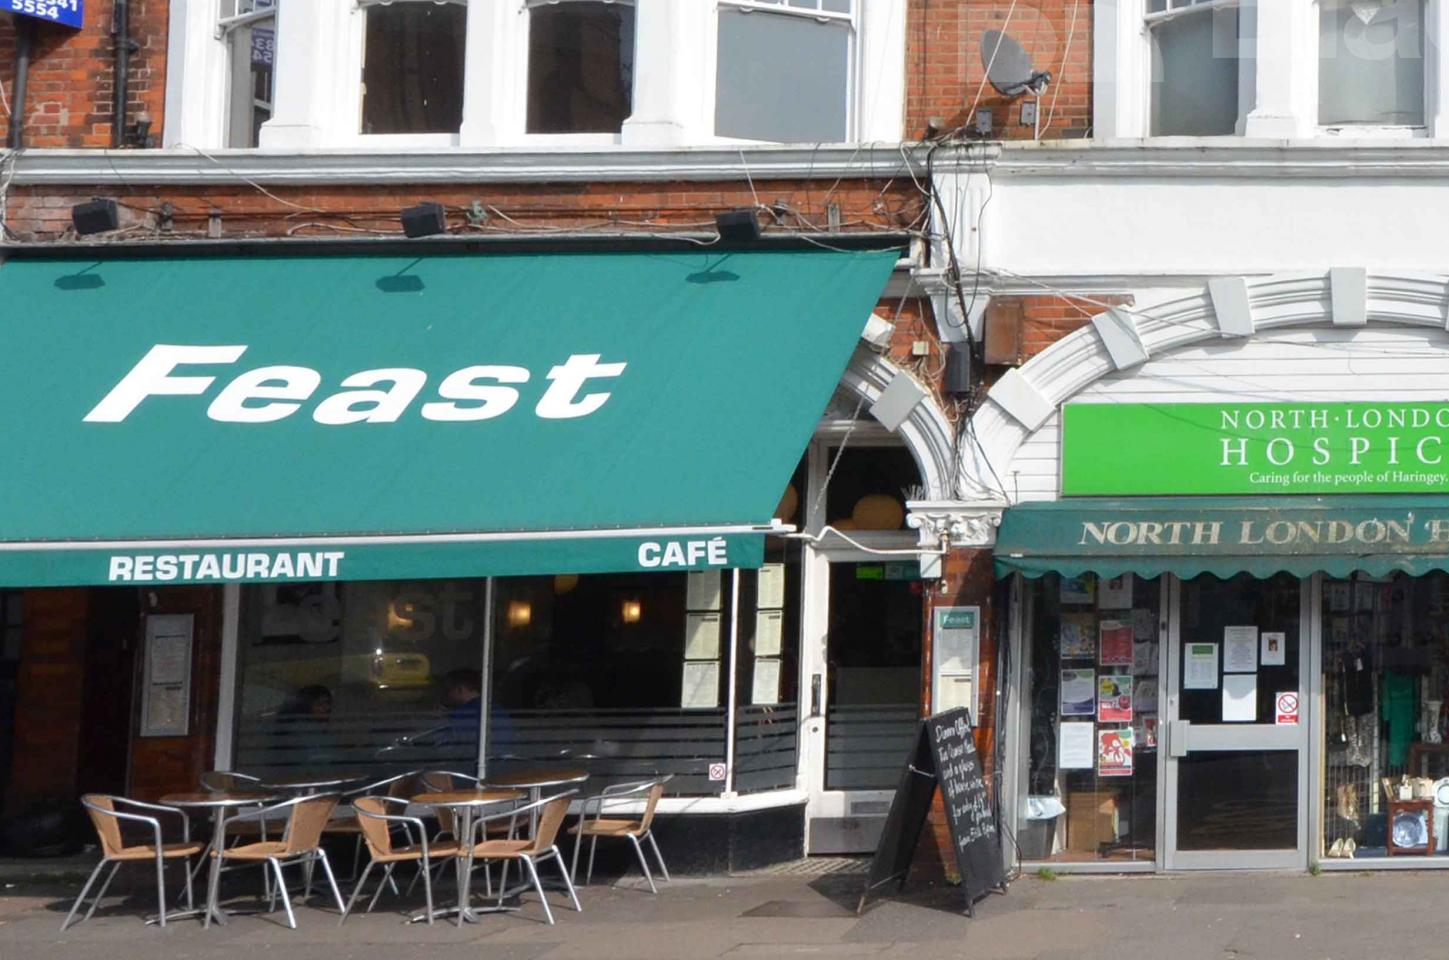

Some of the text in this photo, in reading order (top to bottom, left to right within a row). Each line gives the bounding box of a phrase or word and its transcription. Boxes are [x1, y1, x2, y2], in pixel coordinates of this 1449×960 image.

[82, 344, 628, 425] Feast
[1249, 470, 1449, 486] Caring for the people of Haringey.
[1081, 520, 1224, 545] NORTH
[1238, 517, 1412, 545] LONDON
[108, 536, 729, 582] RESTAURANT CAFÉ
